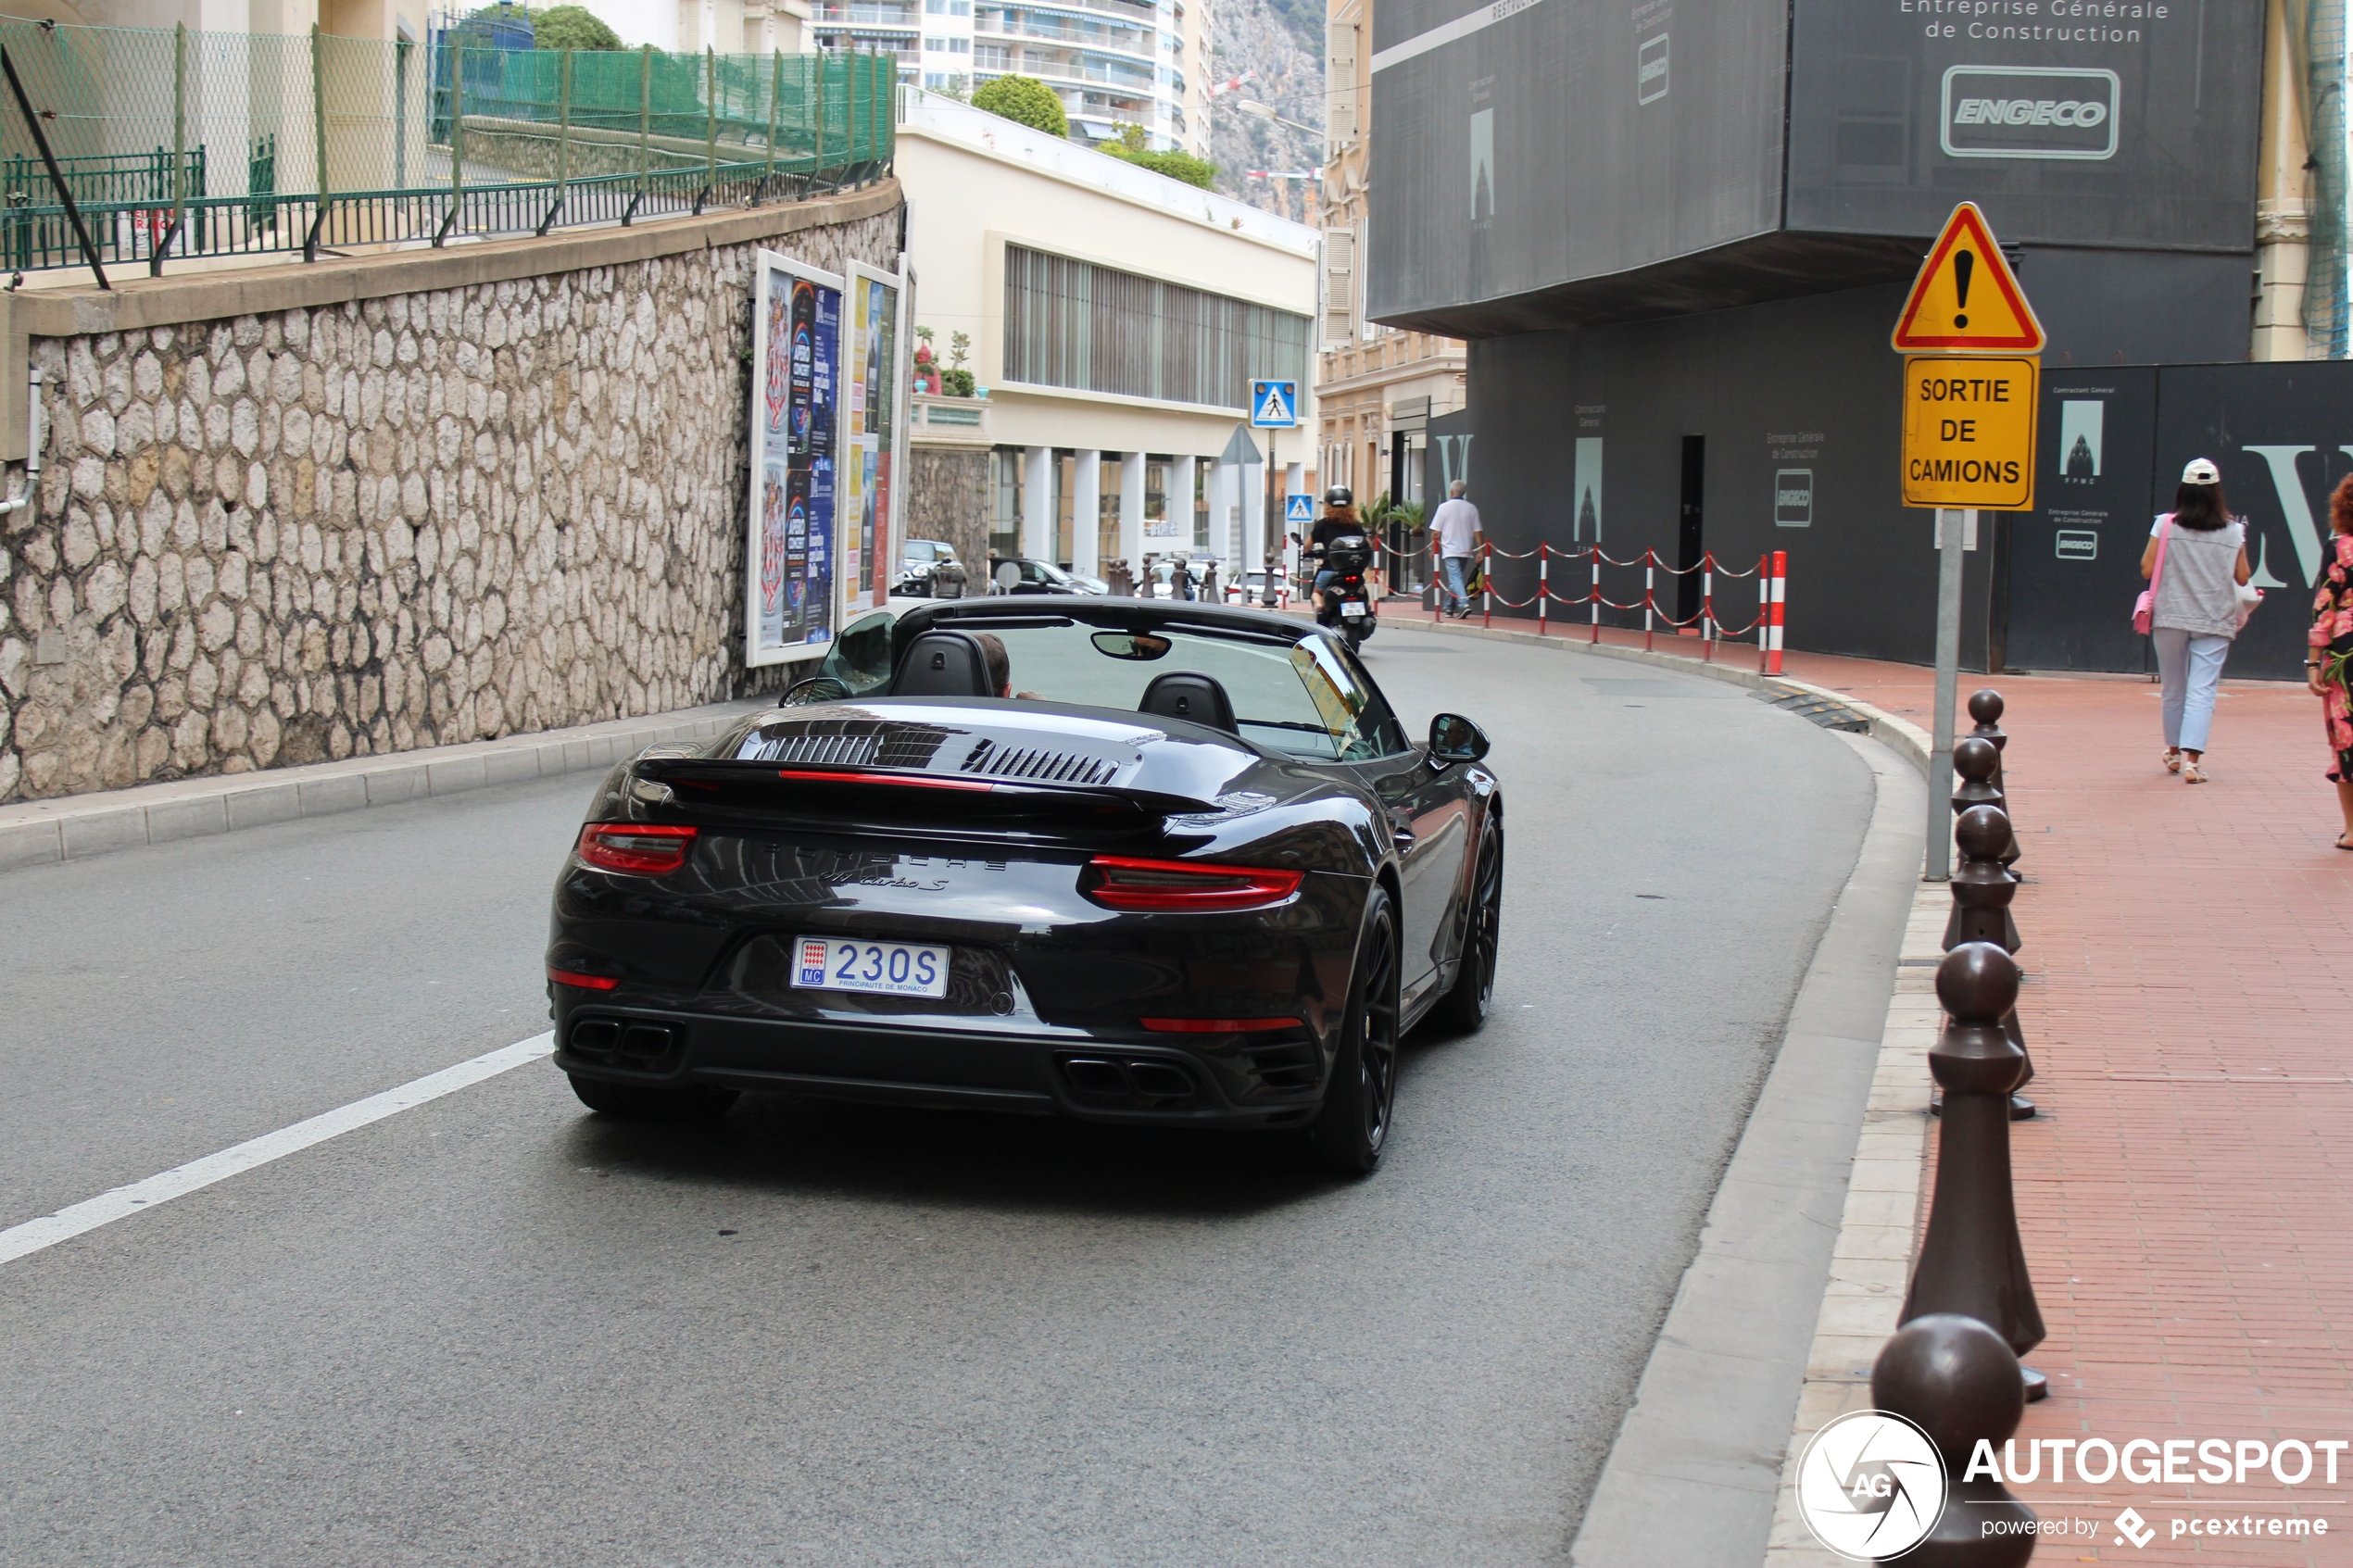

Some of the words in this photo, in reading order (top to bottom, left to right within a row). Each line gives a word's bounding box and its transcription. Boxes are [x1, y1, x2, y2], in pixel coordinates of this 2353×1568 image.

[1900, 0, 2039, 17] Entreprise
[2050, 0, 2169, 19] Générale
[1925, 21, 1956, 38] de
[1968, 21, 2141, 43] Construction
[1953, 98, 2108, 128] ENGECO
[1920, 378, 2009, 402] SORTIE
[1941, 419, 1976, 443] DE
[1909, 458, 2020, 484] CAMIONS
[1778, 489, 1809, 507] ENGECO
[2059, 540, 2094, 550] ENGECO
[819, 871, 854, 883] 911
[859, 873, 920, 888] turbo
[917, 879, 950, 891] S
[836, 944, 937, 985] 230S
[804, 971, 821, 983] MC
[838, 980, 883, 990] PRINCIPAUTE
[897, 984, 928, 993] MONACO
